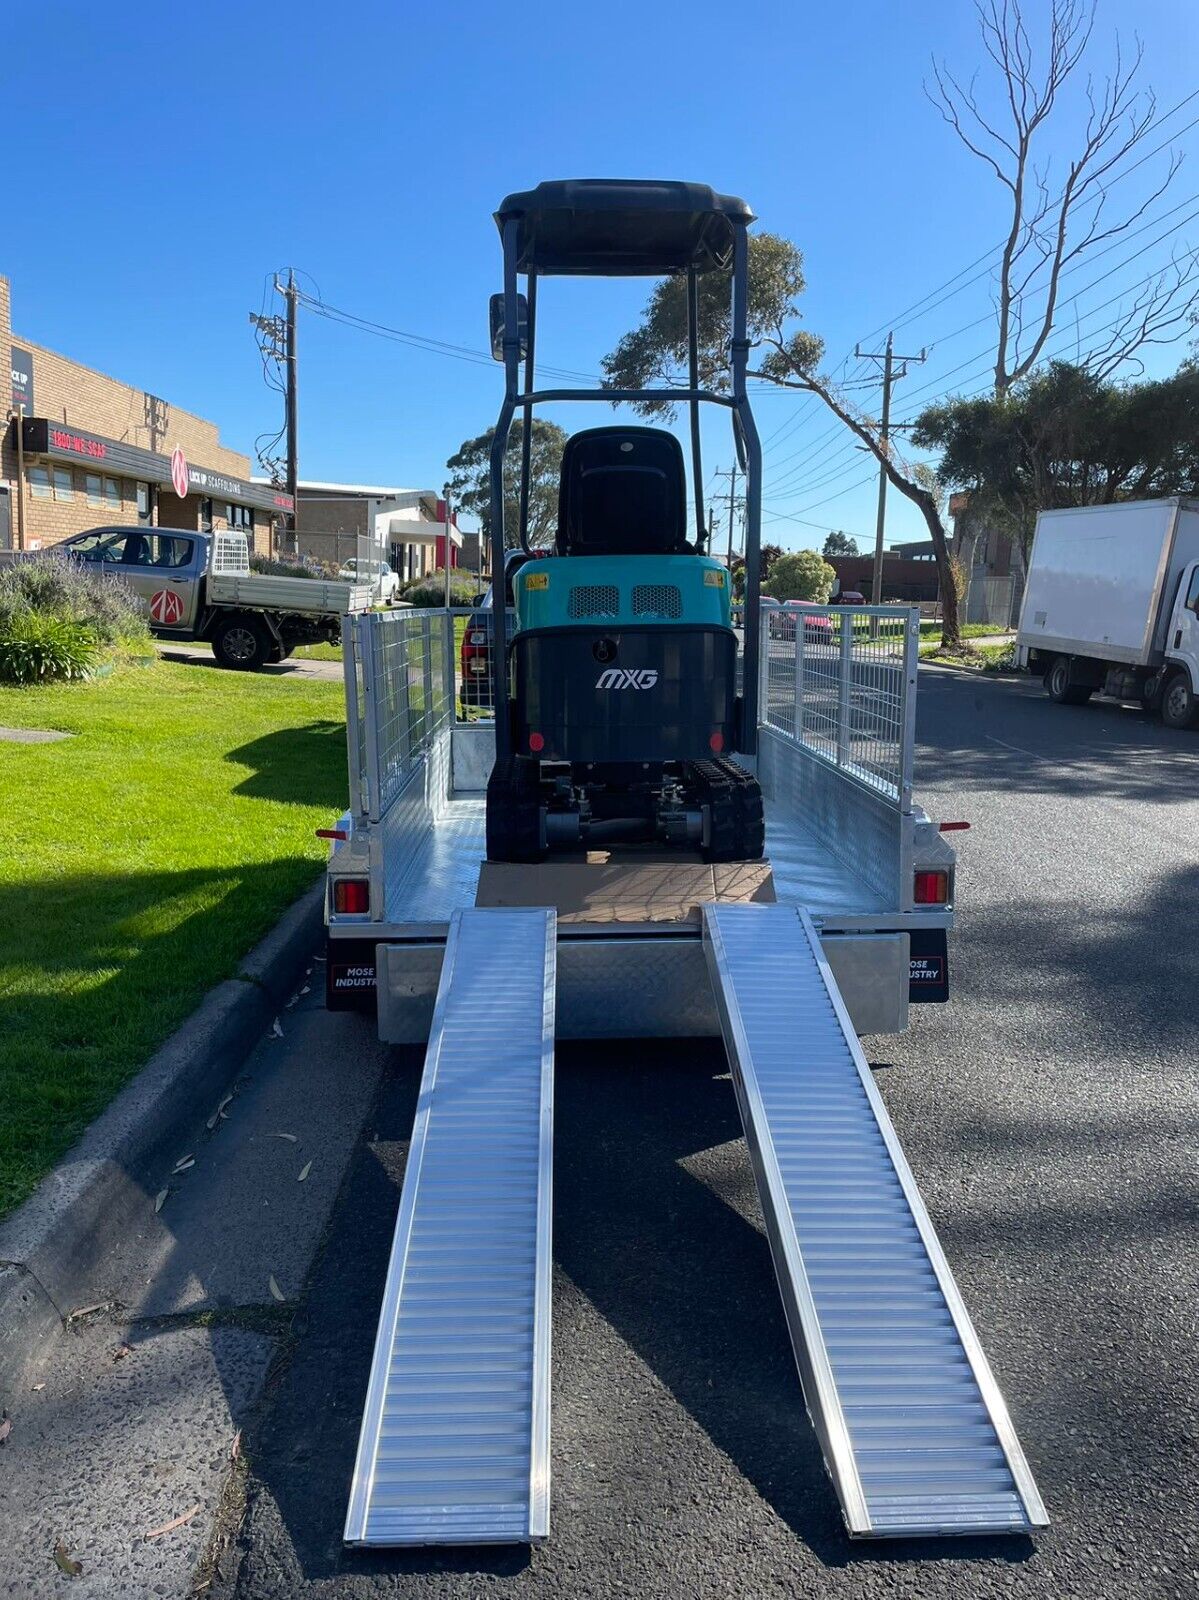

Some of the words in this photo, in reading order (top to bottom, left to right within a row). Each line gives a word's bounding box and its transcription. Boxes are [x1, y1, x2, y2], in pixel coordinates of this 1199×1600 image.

[53, 431, 70, 449] 1800
[208, 475, 241, 494] SCAFFOLDING
[595, 668, 658, 690] MXG
[909, 960, 928, 968] OSE
[347, 967, 375, 977] MOSE
[908, 970, 939, 979] USTRY
[335, 978, 378, 987] INDUSTR
